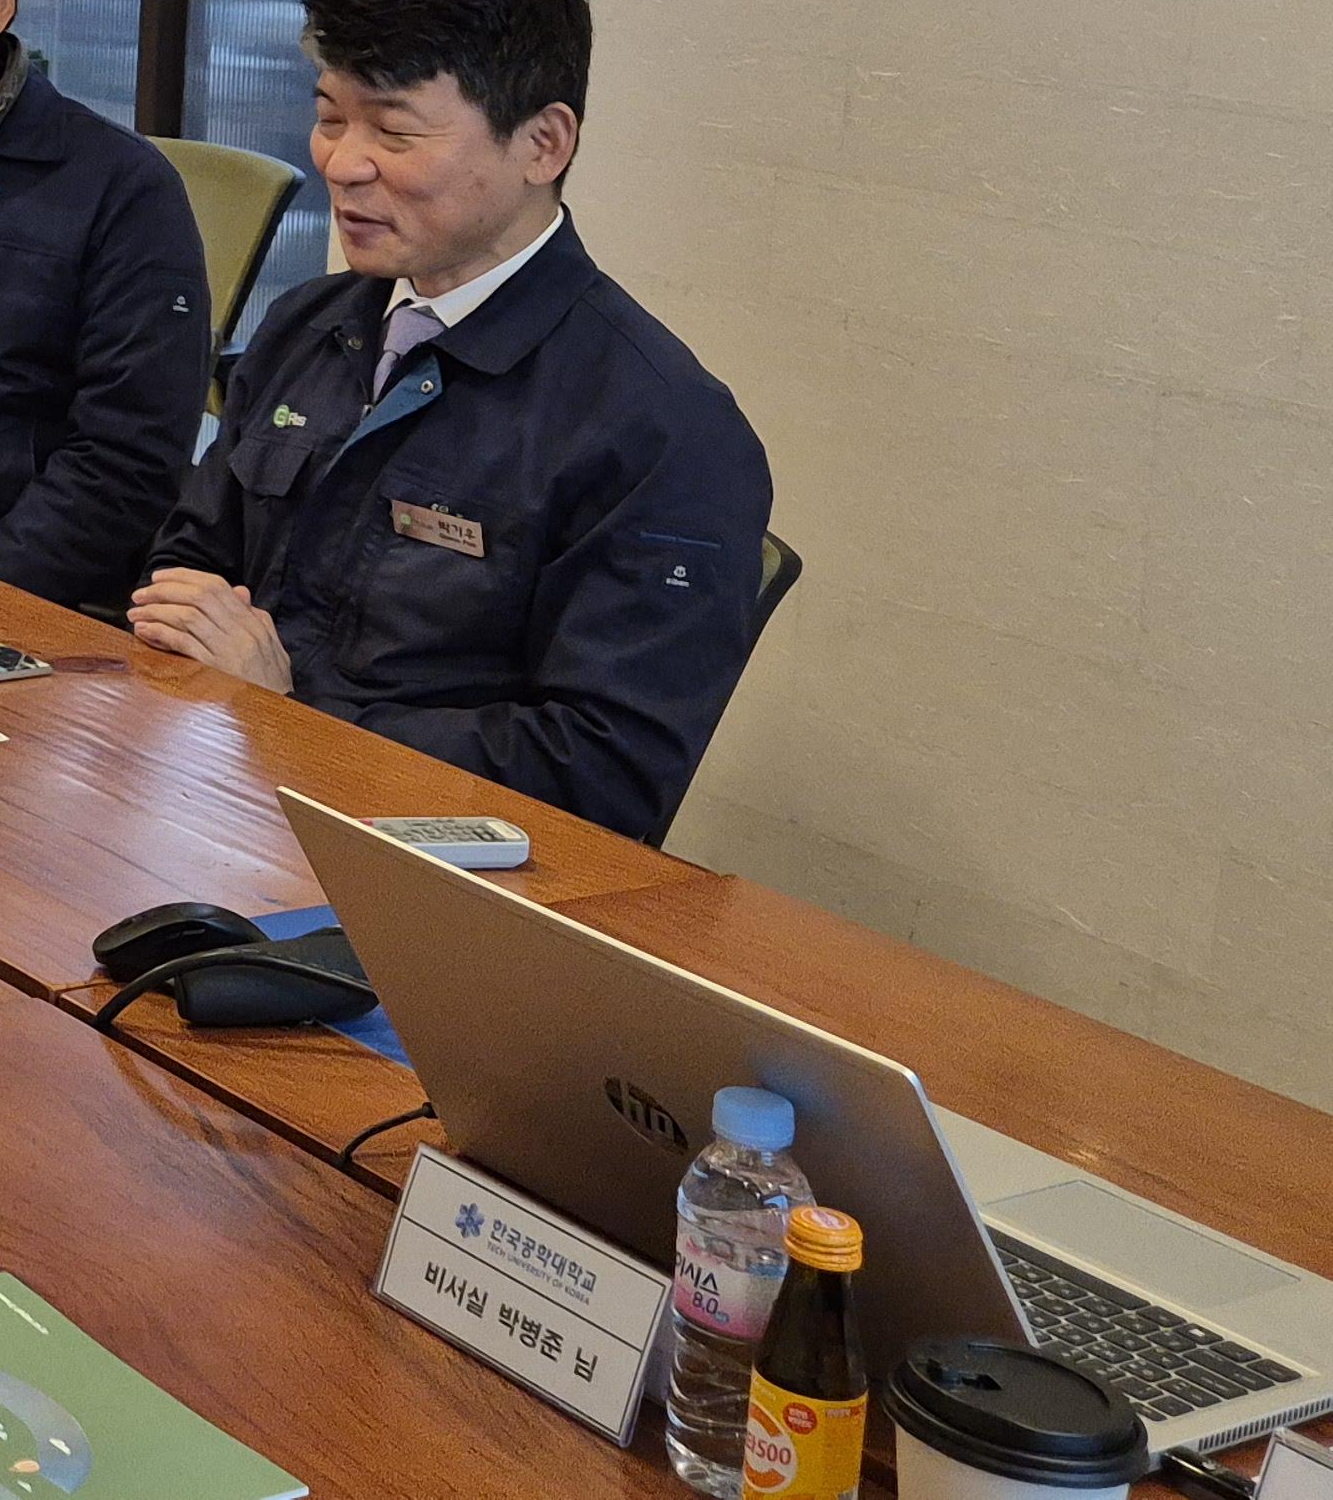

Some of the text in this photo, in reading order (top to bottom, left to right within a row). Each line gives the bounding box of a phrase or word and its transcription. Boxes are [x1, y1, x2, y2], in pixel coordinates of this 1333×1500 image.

[486, 1241, 591, 1306] TECH UNIVERSITY OF KOREA
[490, 1218, 598, 1293] 한국공학대학교
[424, 1261, 599, 1383] 비서실 박병준 님
[693, 1293, 719, 1315] 8.0
